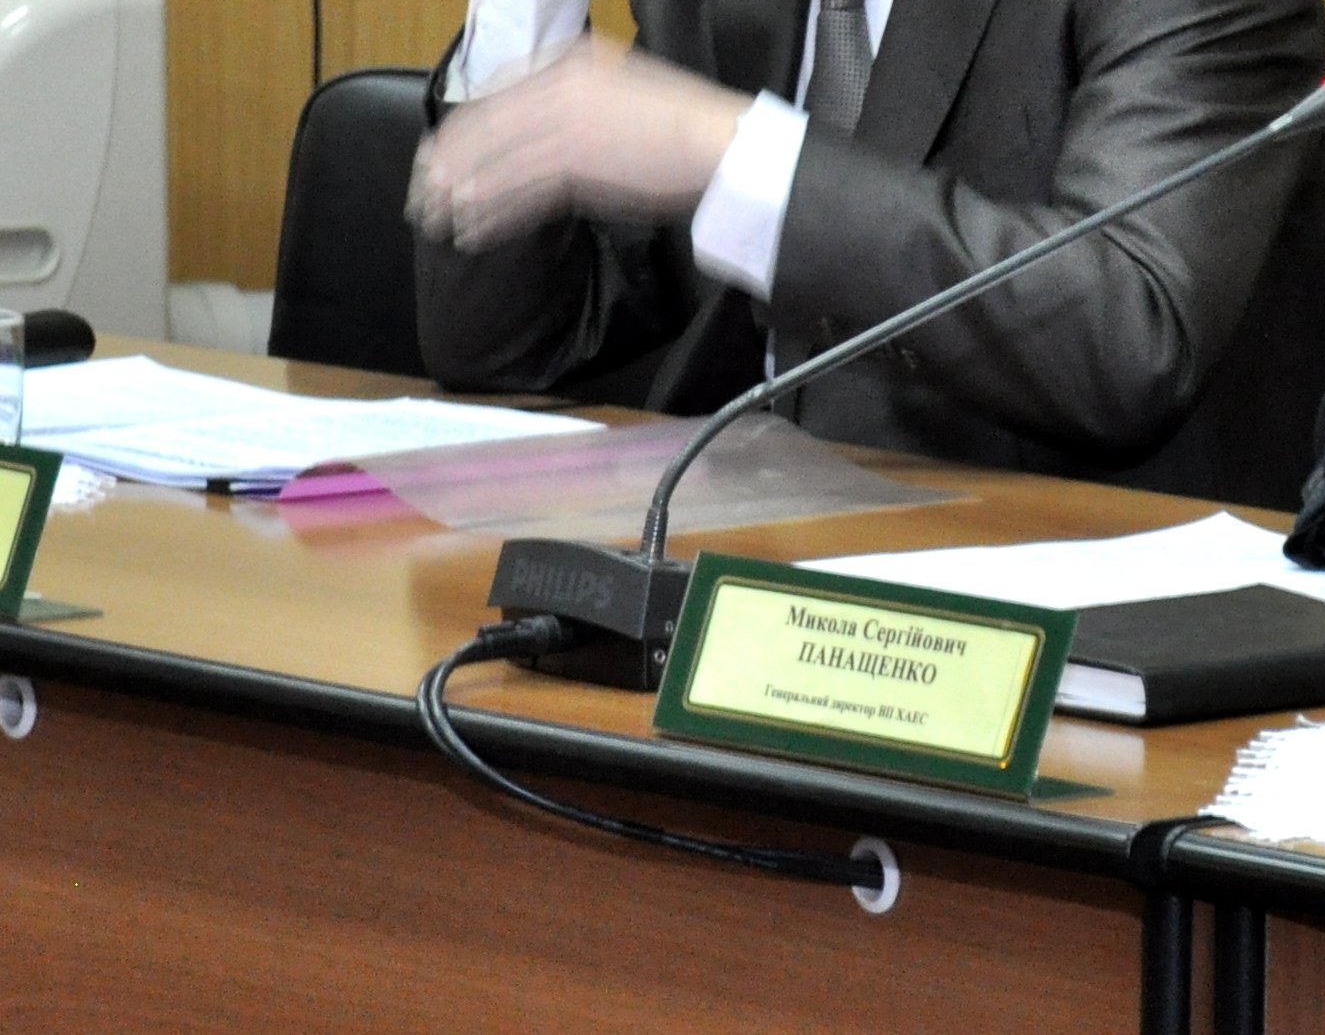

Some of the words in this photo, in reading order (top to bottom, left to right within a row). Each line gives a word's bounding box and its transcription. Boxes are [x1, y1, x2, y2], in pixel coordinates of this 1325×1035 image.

[510, 558, 614, 609] PHILIPS
[785, 605, 857, 637] Микола
[863, 618, 967, 656] Сергійович
[797, 641, 937, 685] ПАНАЩЕНКО
[764, 683, 829, 707] Генеральний
[830, 699, 876, 718] директор
[895, 707, 929, 726] ХАЕС
